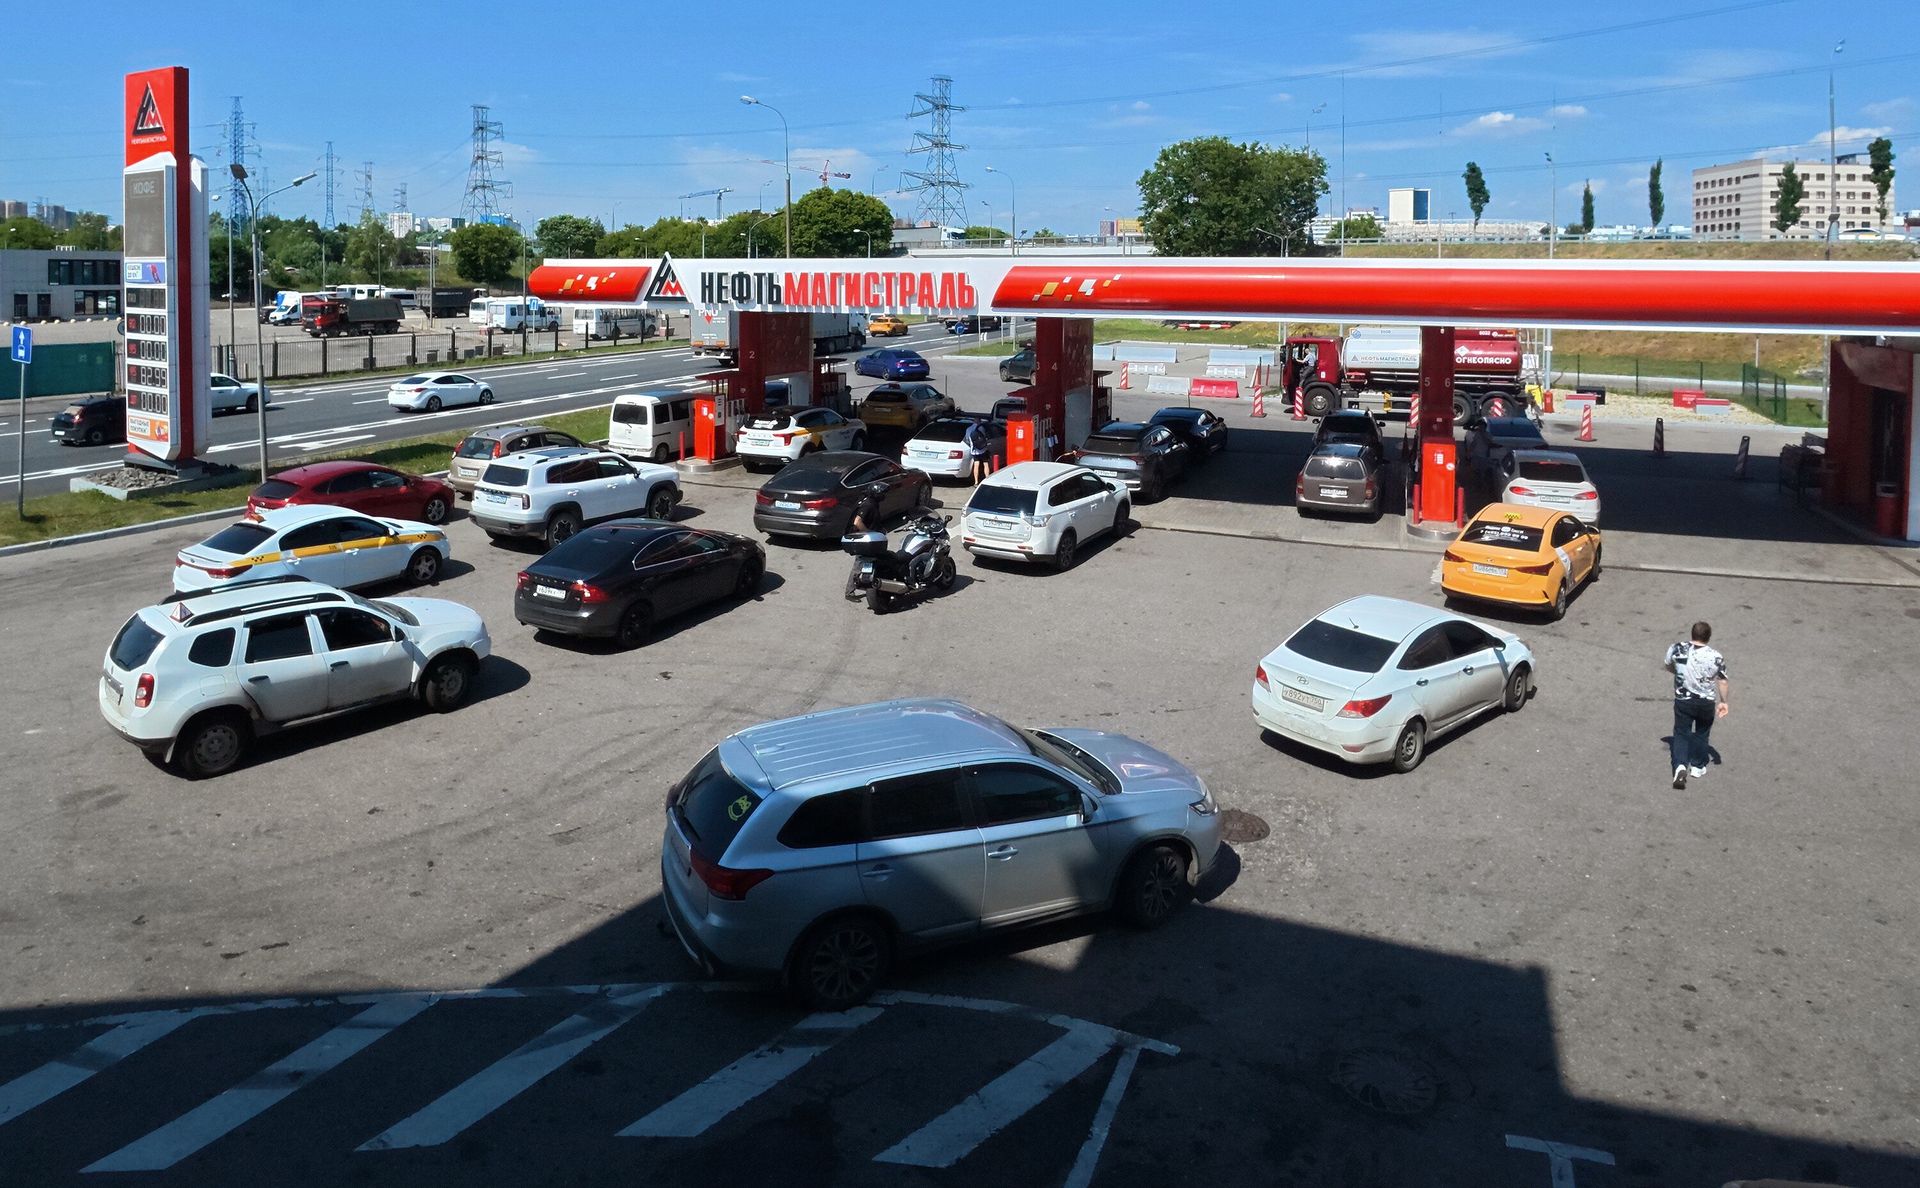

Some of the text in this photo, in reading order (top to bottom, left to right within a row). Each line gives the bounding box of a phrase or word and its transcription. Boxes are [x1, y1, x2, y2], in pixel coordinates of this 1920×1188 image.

[749, 351, 755, 359] 2
[1455, 356, 1512, 365] ОГНЕОПАСНО
[1051, 362, 1058, 371] 4
[141, 366, 167, 388] 82.99
[1424, 377, 1431, 387] 5
[1445, 378, 1451, 388] 6
